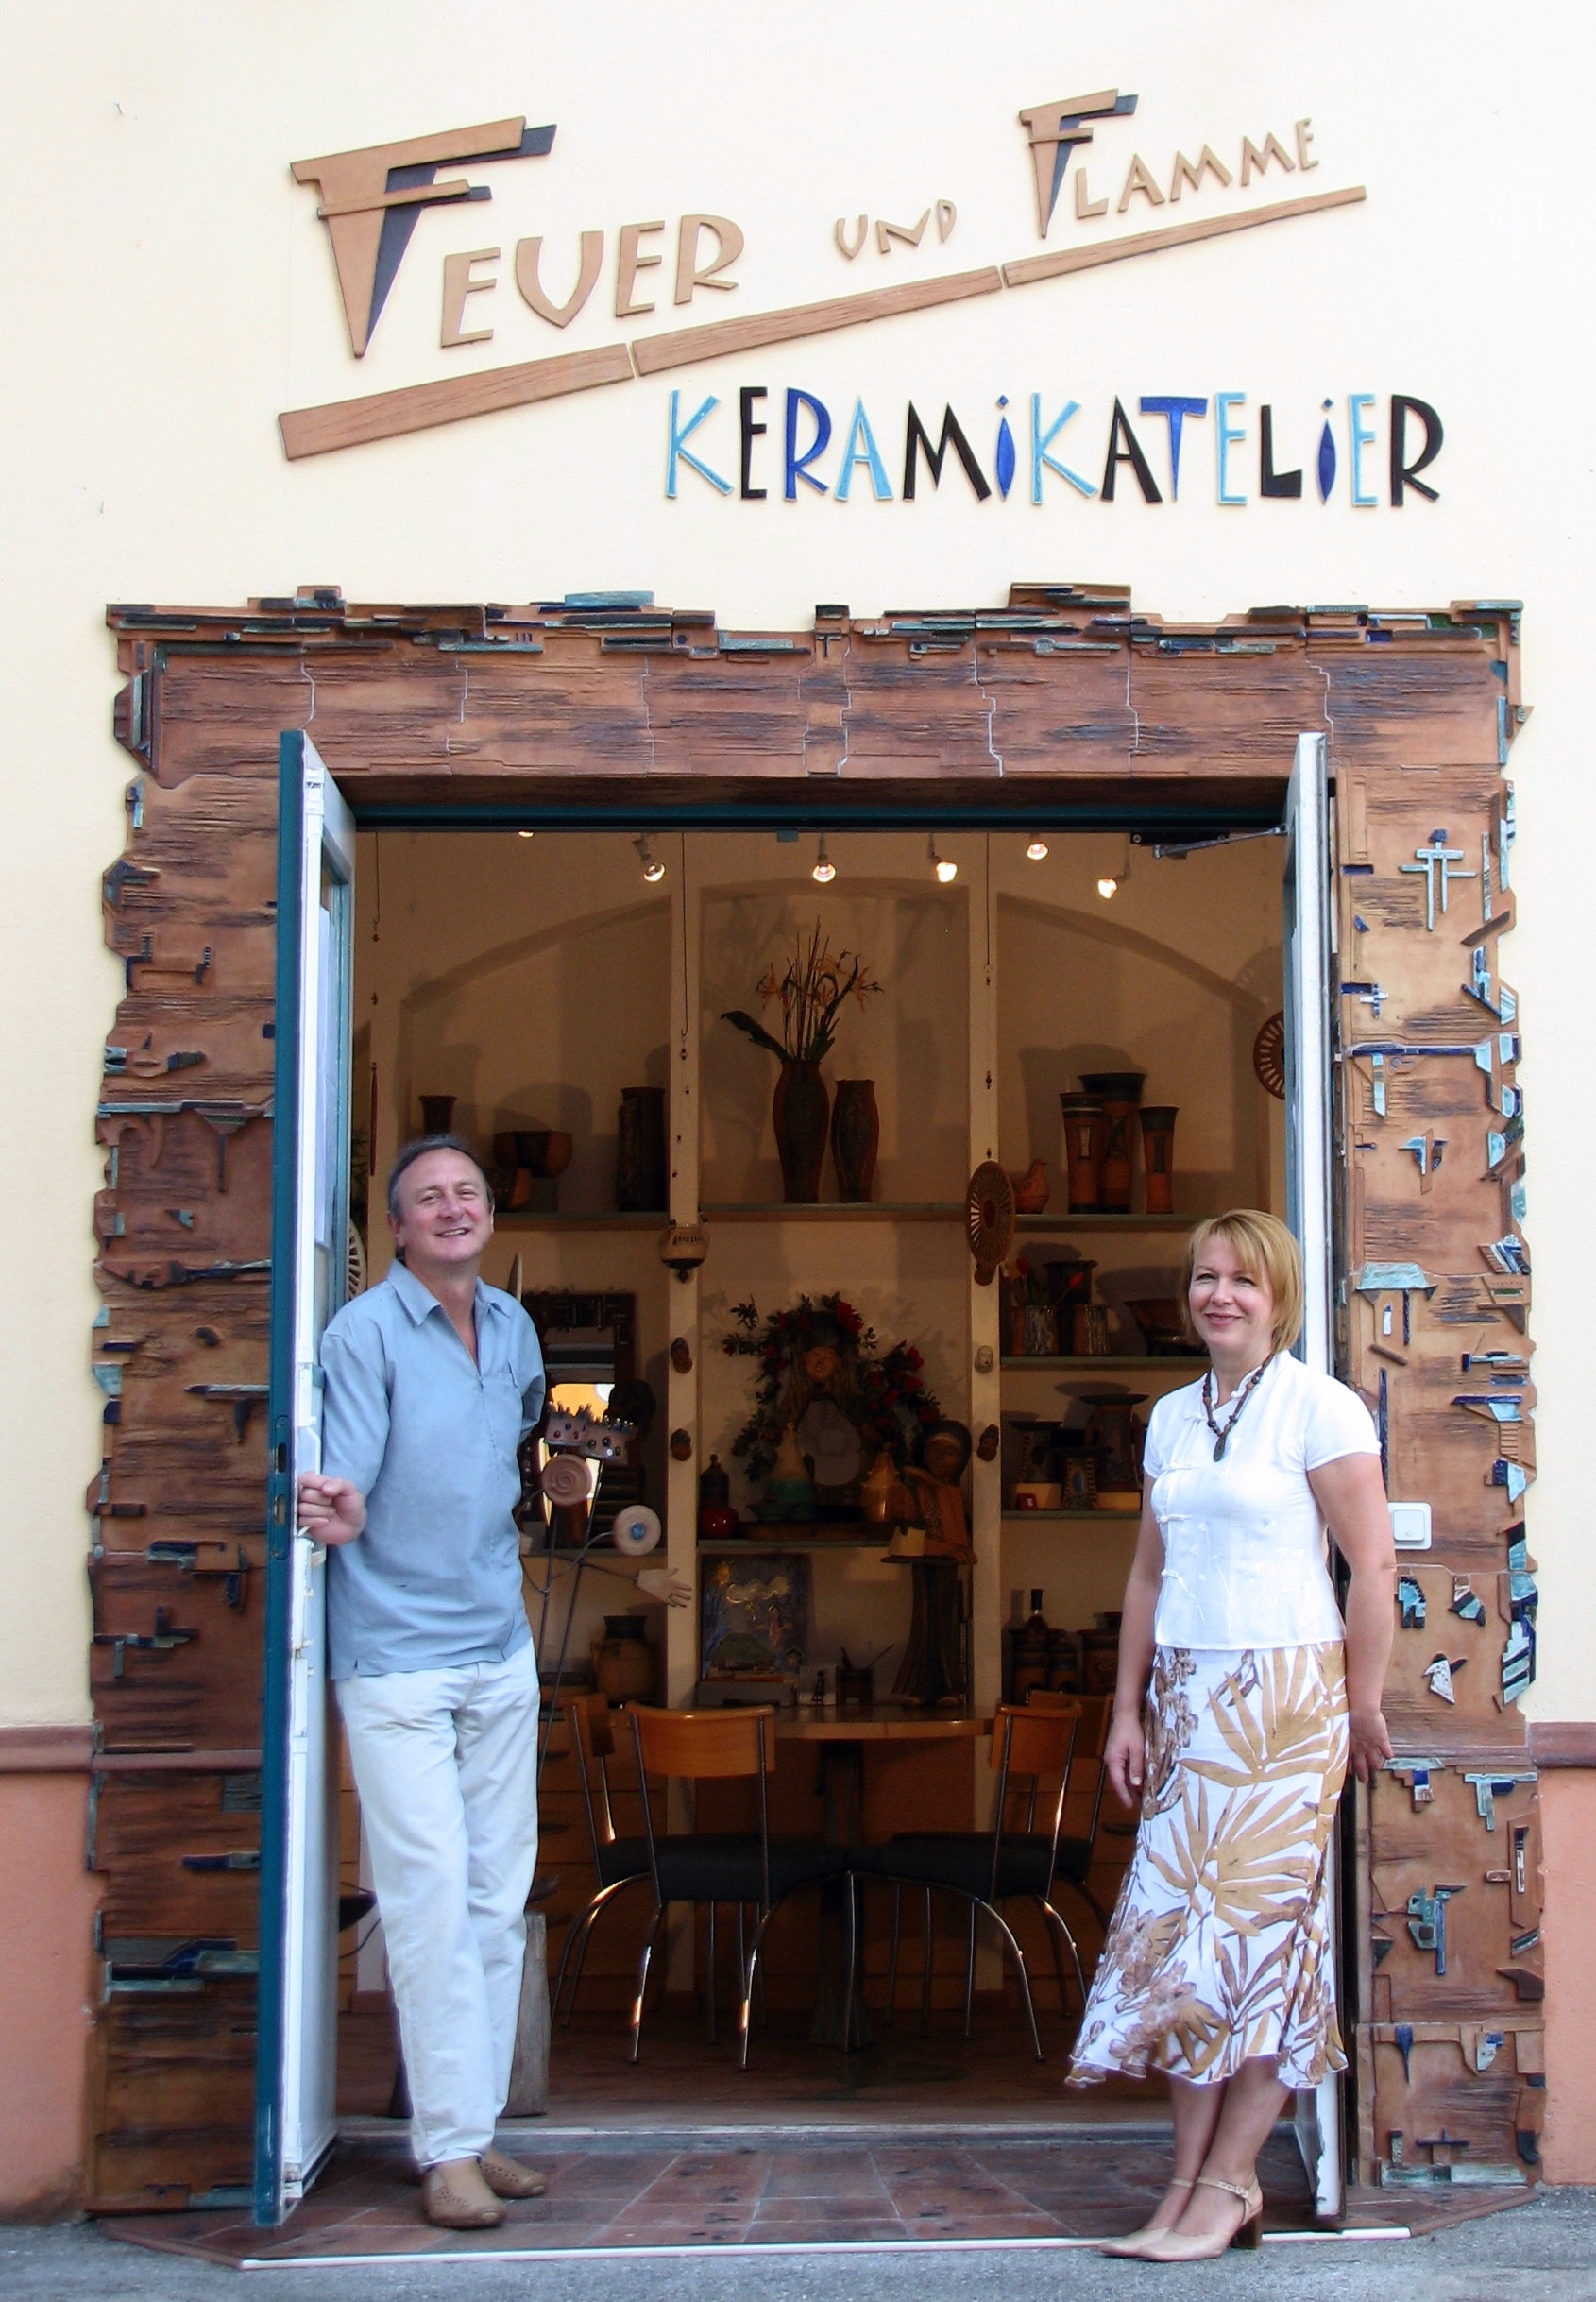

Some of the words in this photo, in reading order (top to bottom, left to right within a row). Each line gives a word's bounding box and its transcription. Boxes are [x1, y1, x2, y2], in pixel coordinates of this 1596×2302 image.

[290, 115, 745, 359] FEUER
[834, 198, 957, 260] UND
[1018, 88, 1320, 238] FLAMME
